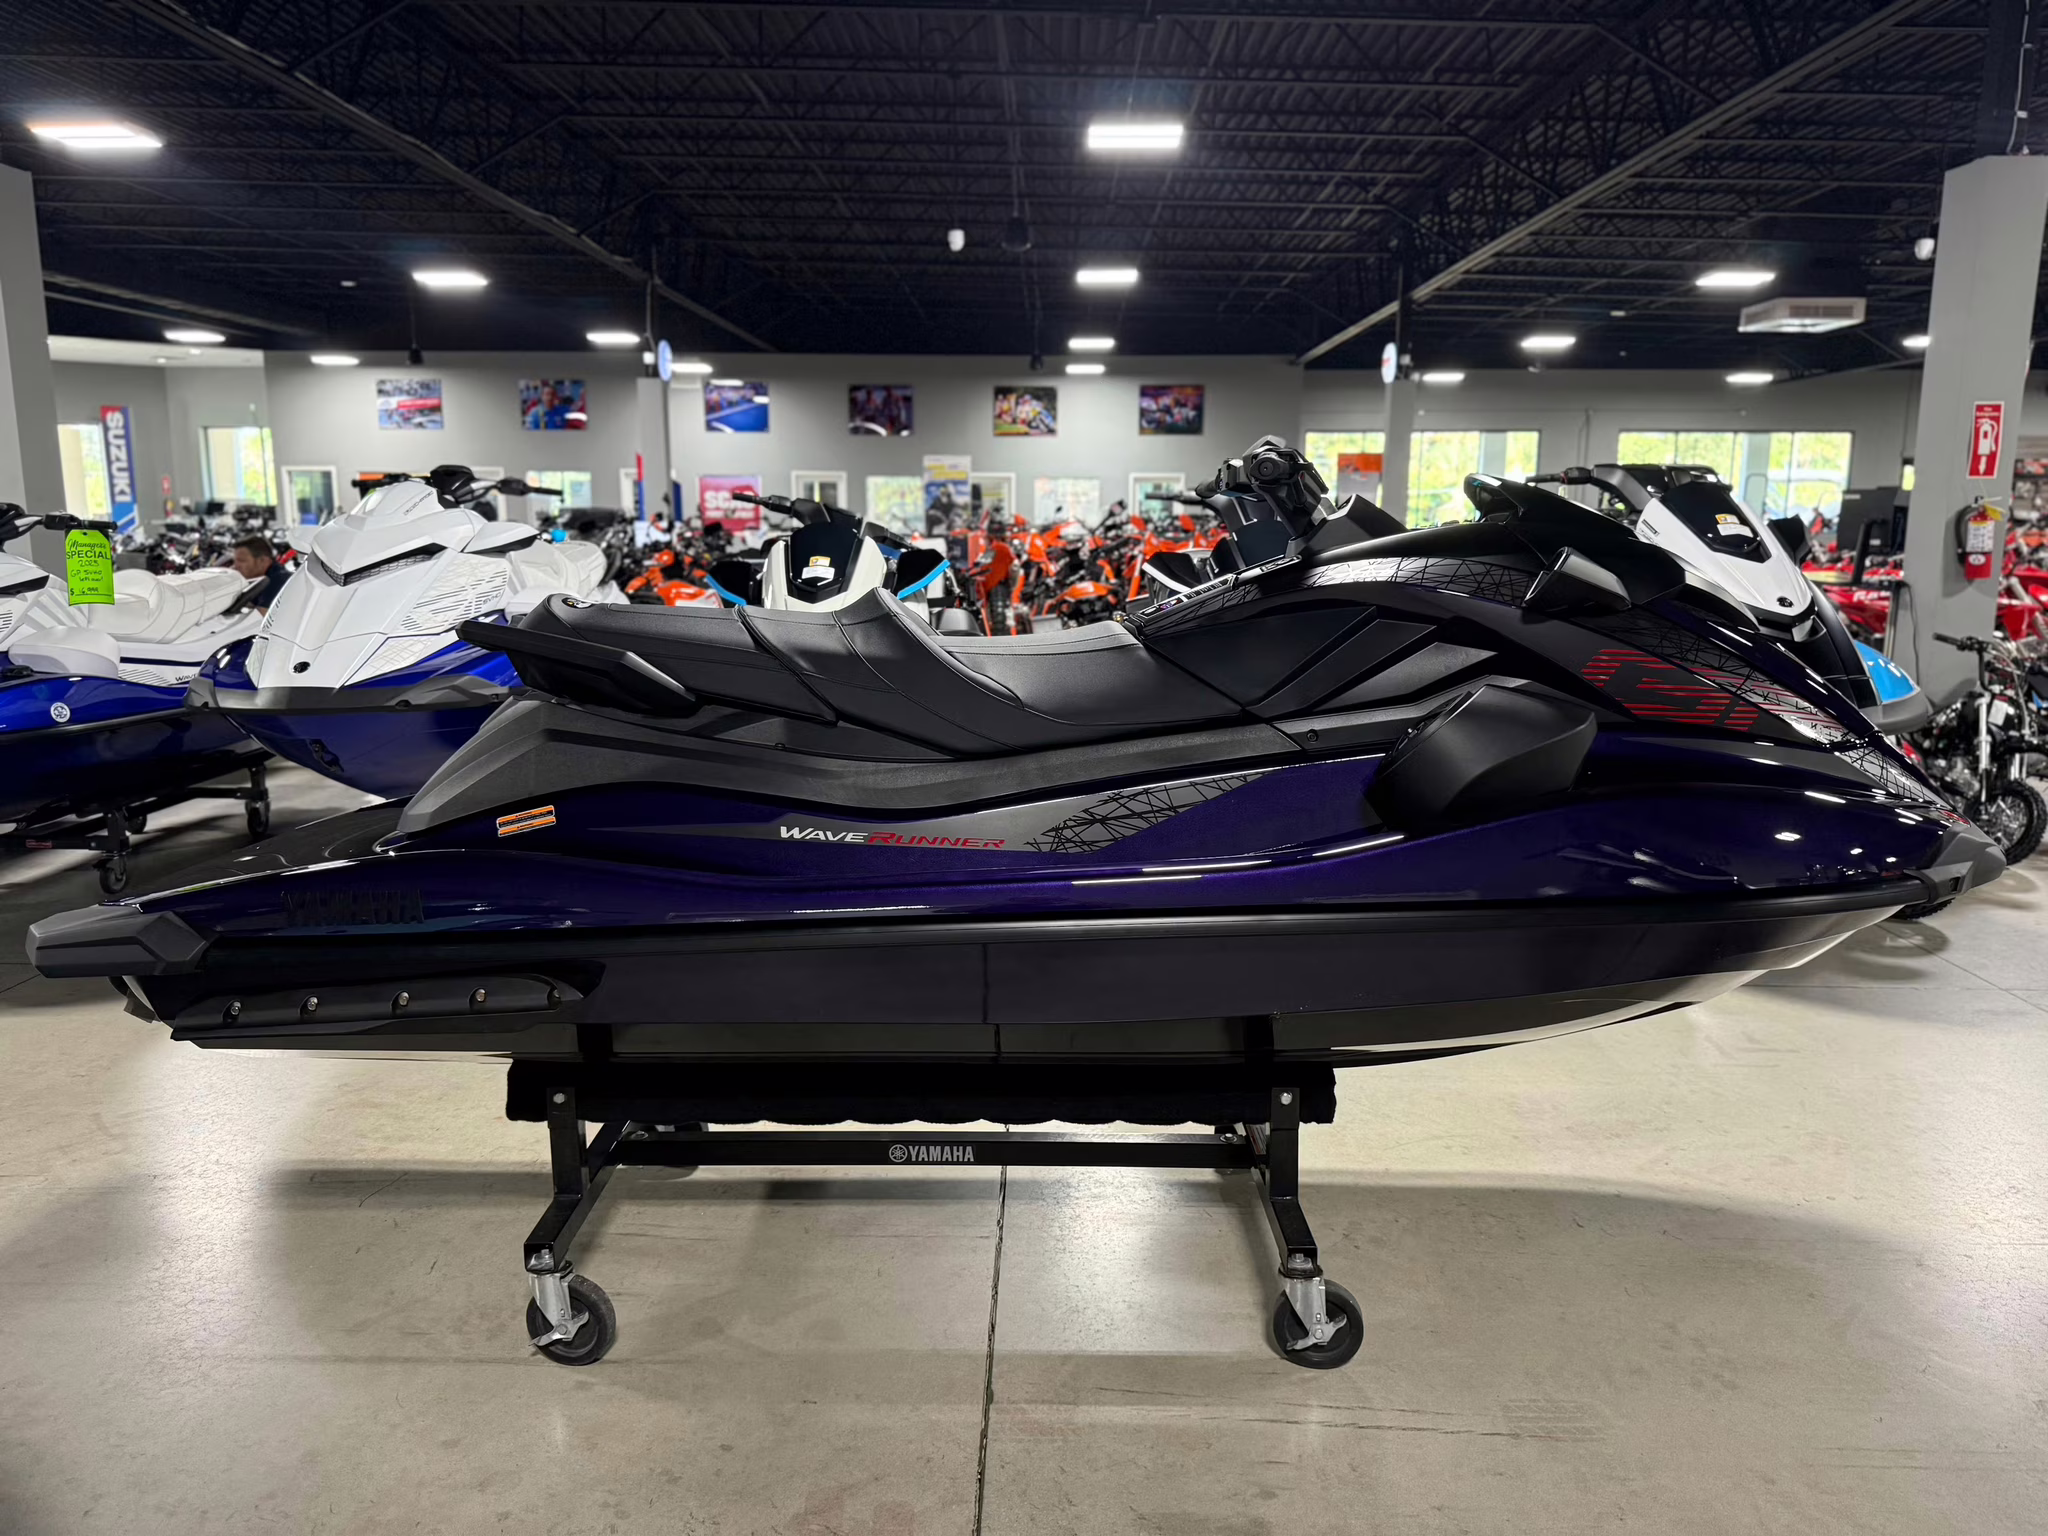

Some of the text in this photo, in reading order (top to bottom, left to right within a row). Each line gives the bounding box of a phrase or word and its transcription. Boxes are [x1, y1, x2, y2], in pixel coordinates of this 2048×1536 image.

[106, 411, 132, 502] SUZUKI
[66, 550, 110, 560] SPECIAL
[780, 826, 1005, 849] WAVERUNNER
[908, 1145, 975, 1162] YAMAHA
